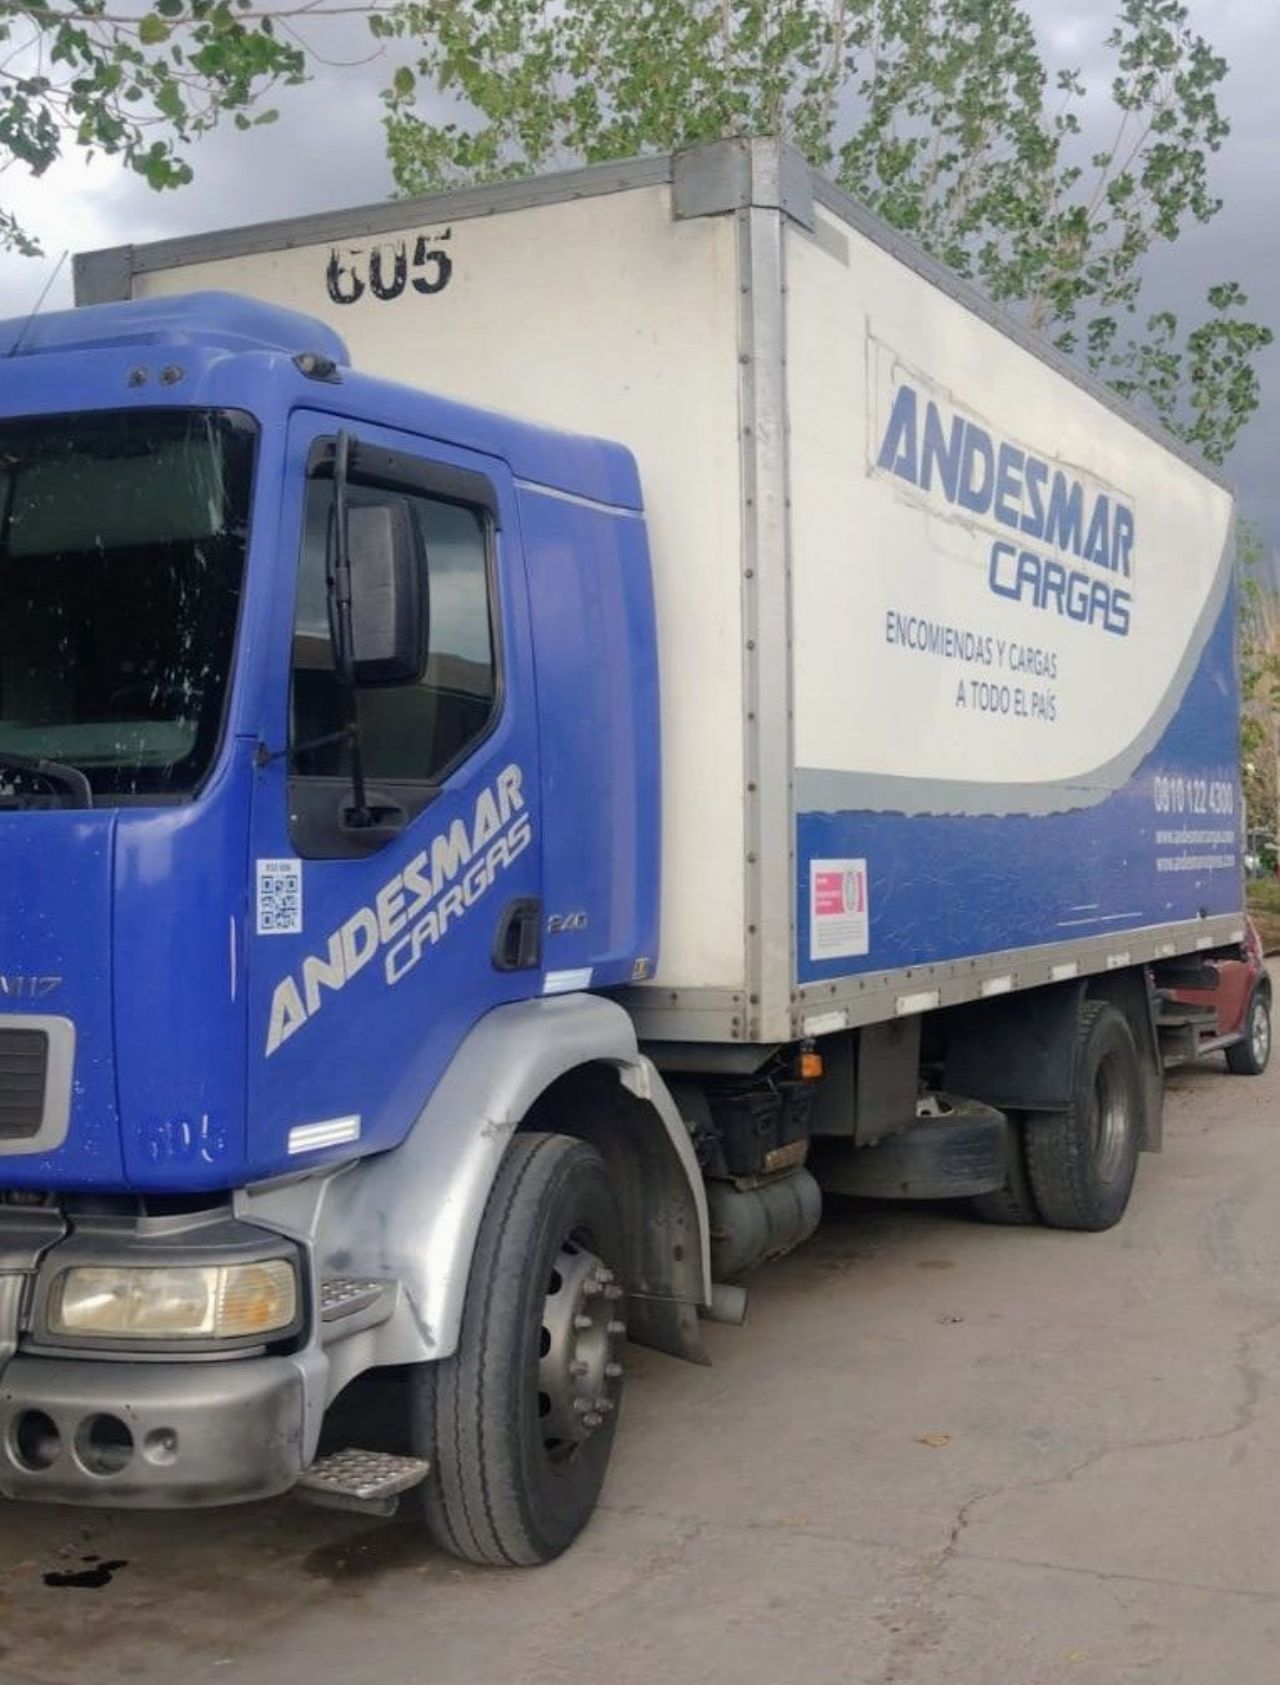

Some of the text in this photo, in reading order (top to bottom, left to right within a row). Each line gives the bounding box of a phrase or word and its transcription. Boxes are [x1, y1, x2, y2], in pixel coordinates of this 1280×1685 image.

[327, 226, 452, 304] 605
[877, 384, 1135, 578] ANDESMAR
[988, 540, 1133, 637] CARGAS
[886, 611, 1057, 679] ENCOMIENDAS Y CARGAS
[955, 679, 1057, 721] A TODO EL PAÍS
[264, 763, 524, 1059] ANDESMAR
[384, 812, 533, 985] CARGAS
